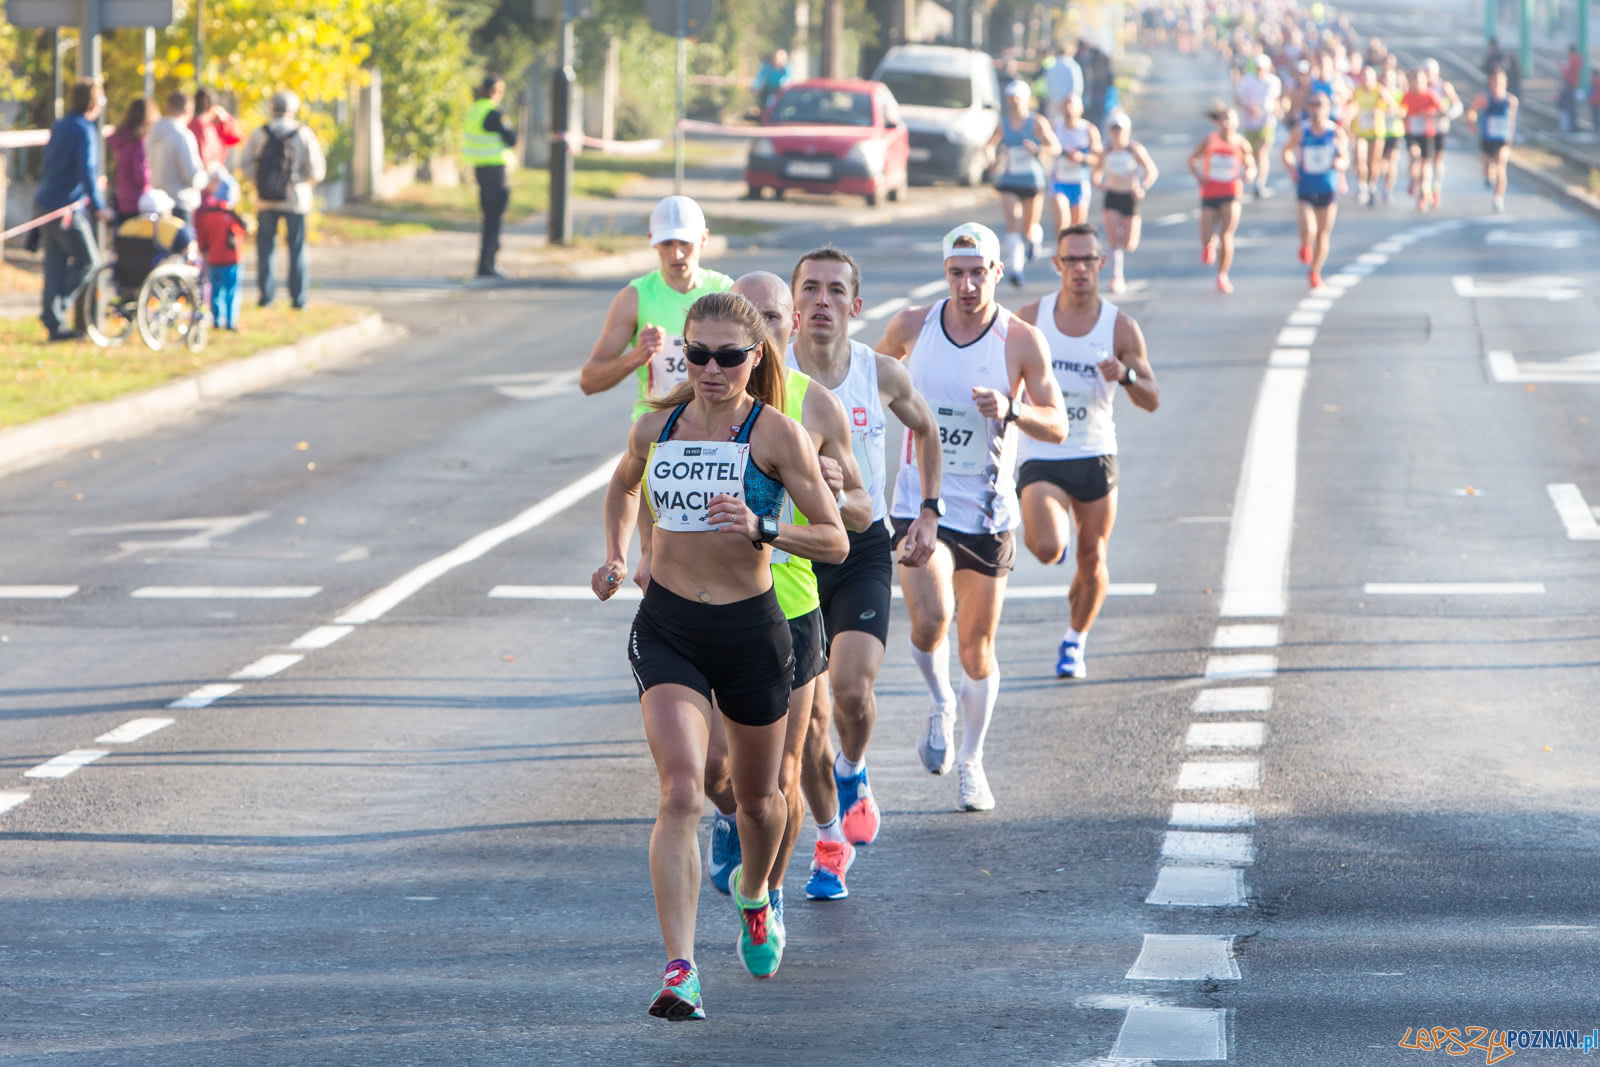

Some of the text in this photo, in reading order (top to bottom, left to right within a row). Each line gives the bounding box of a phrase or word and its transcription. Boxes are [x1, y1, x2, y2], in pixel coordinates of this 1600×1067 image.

[665, 357, 687, 373] 36
[1067, 407, 1087, 421] 50
[654, 461, 739, 480] GORTEL
[653, 490, 739, 511] MACI
